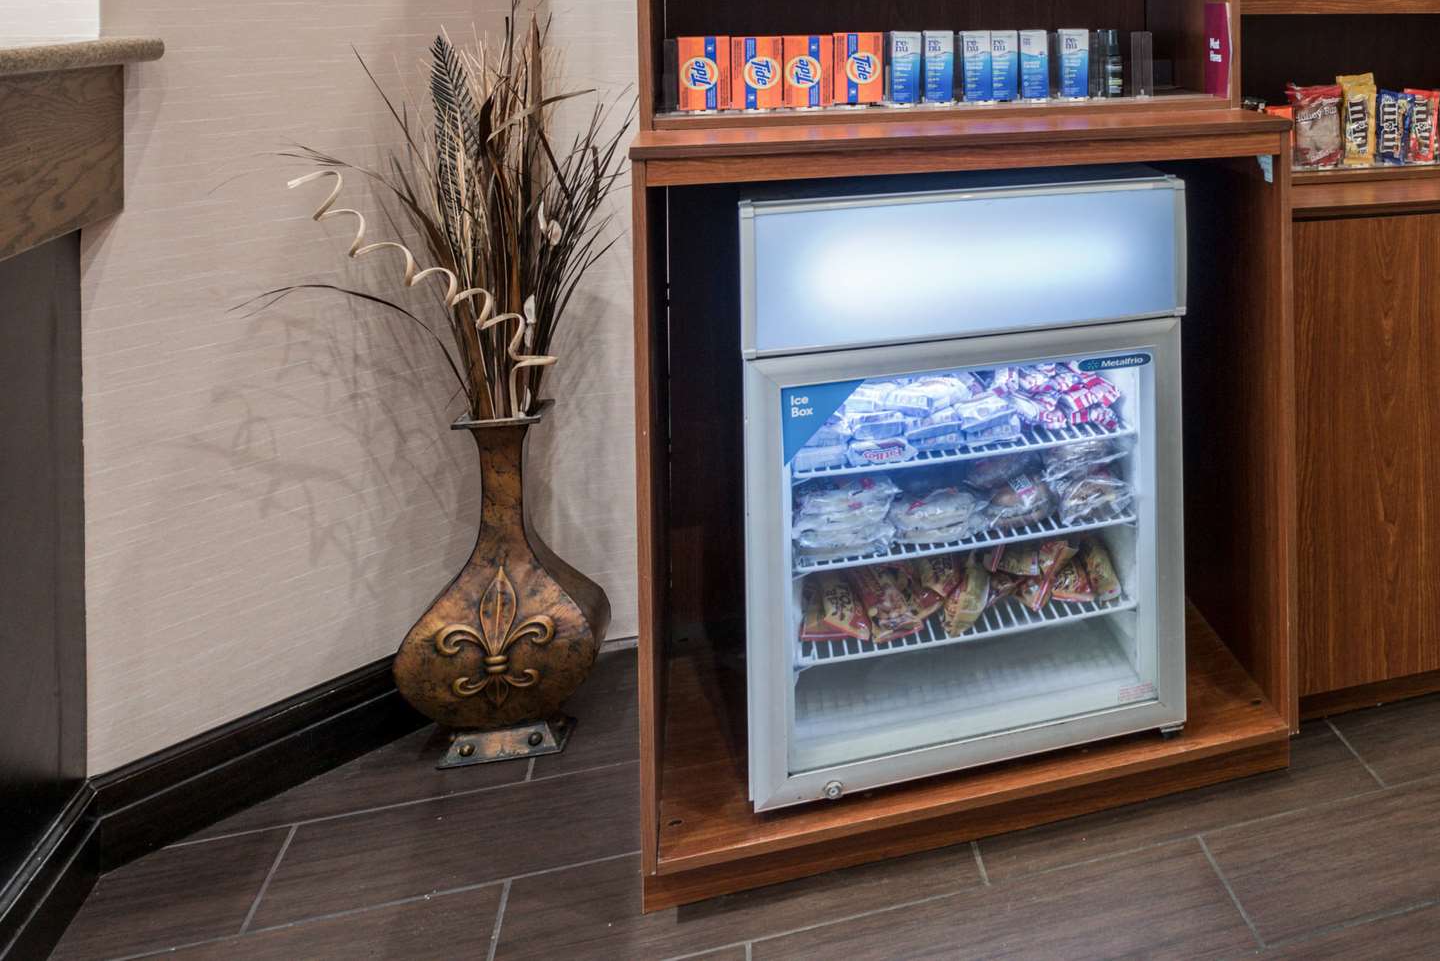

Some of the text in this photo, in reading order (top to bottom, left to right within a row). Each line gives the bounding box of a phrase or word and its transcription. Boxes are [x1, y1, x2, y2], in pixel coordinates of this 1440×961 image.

[691, 60, 711, 87] Tide
[751, 59, 772, 86] Tide
[794, 58, 815, 85] Tide
[852, 54, 872, 81] Tide
[1101, 357, 1144, 368] Metalfrio
[790, 395, 809, 407] Ice
[791, 406, 814, 418] Box
